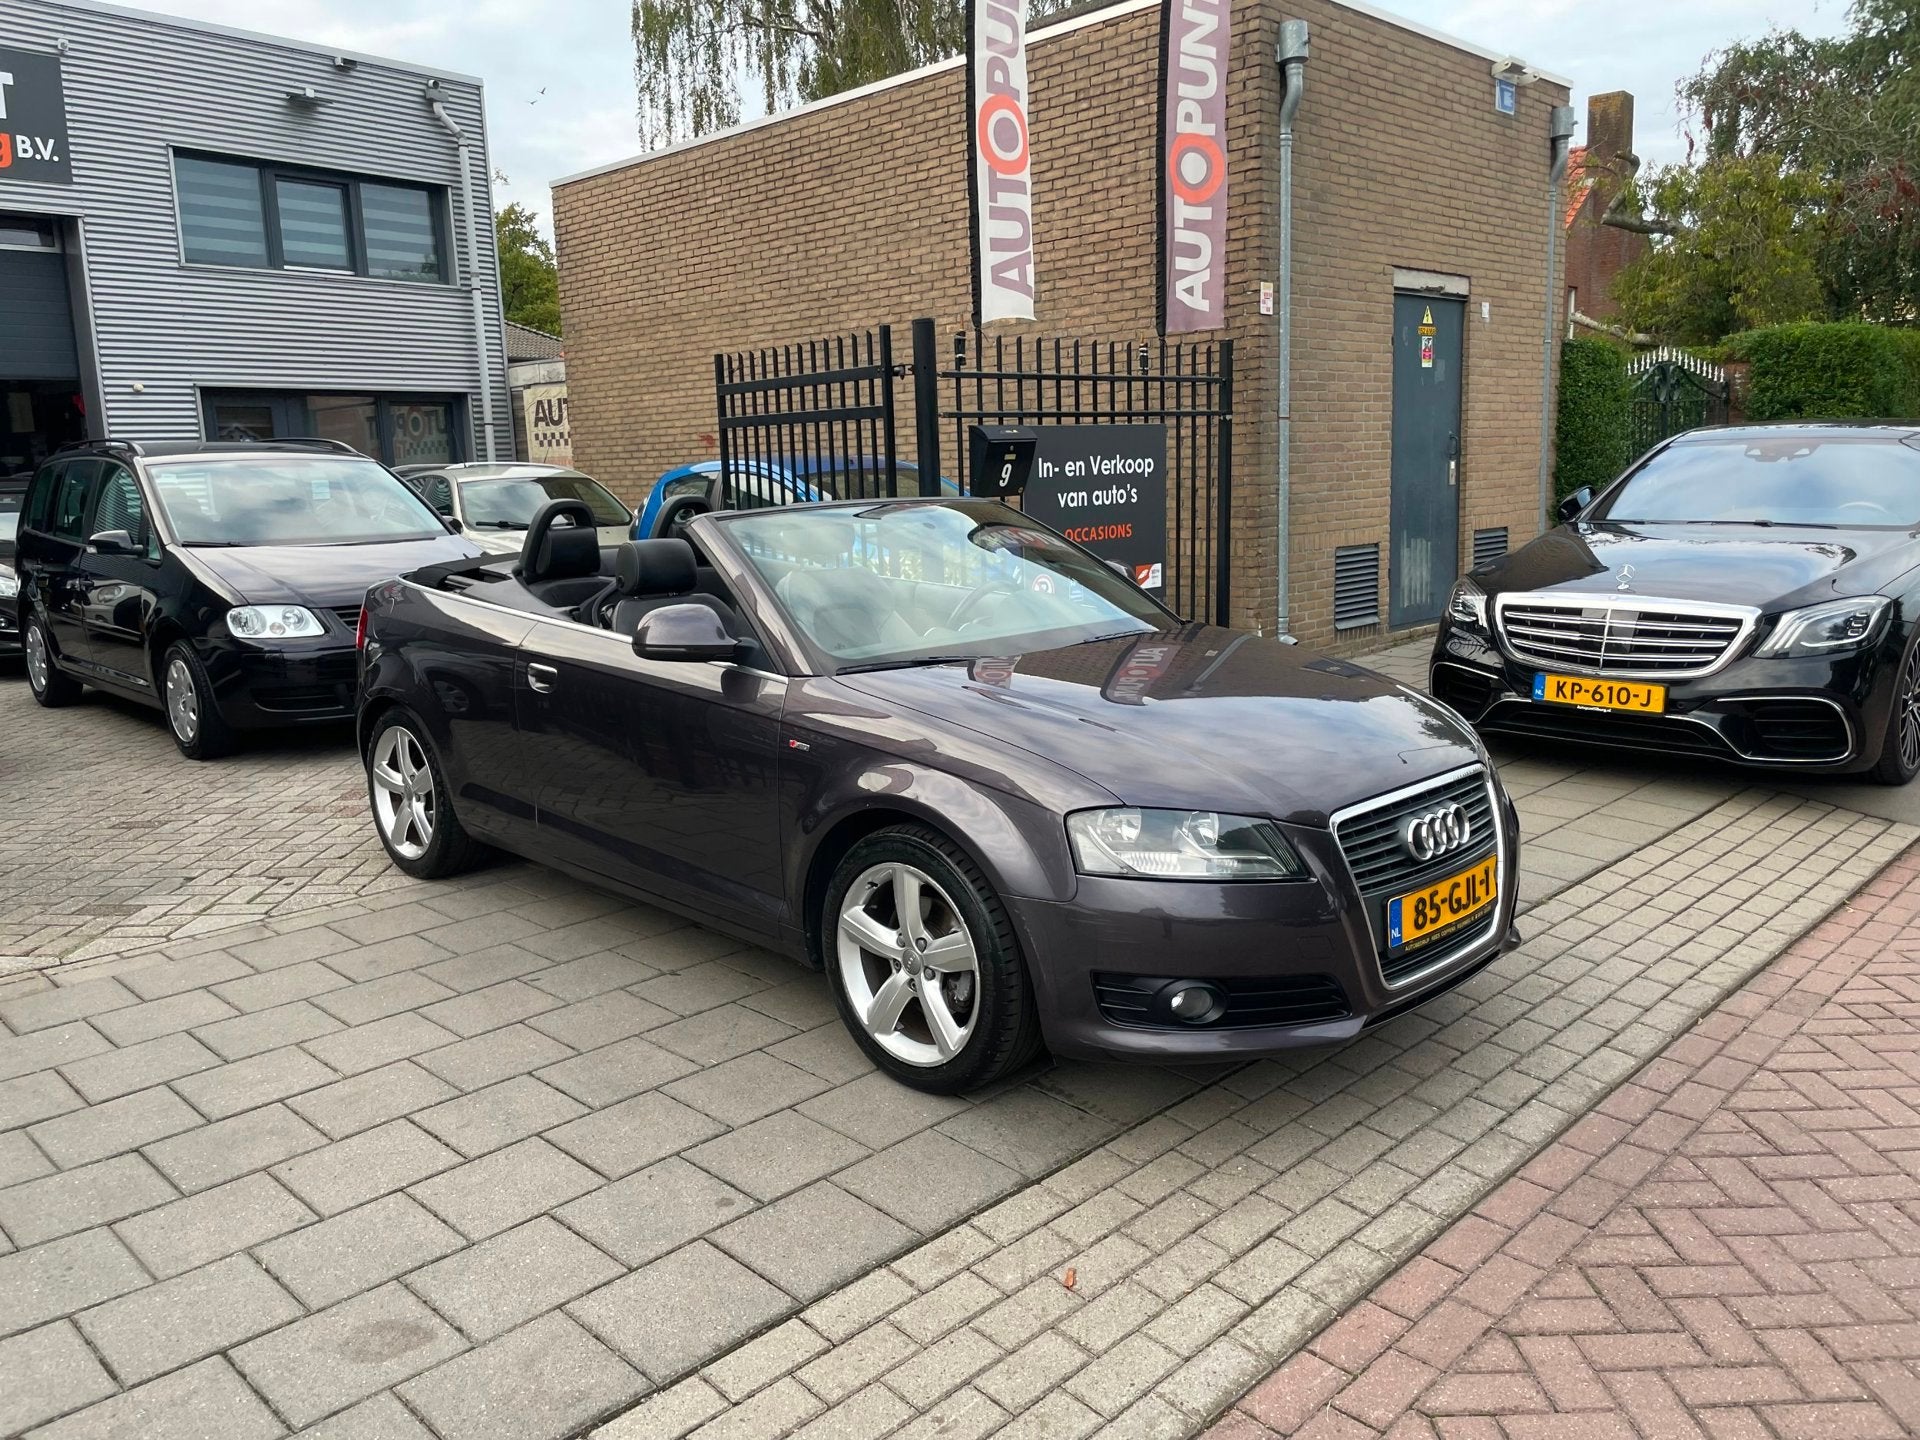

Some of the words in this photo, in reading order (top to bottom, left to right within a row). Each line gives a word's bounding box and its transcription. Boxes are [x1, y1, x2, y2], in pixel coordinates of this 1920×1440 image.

[15, 134, 59, 163] B.V.
[978, 0, 1034, 299] AUTOPU
[1169, 0, 1226, 312] AUTOPUN
[534, 397, 568, 428] AU
[999, 463, 1012, 487] 9
[1038, 457, 1060, 478] In-
[1065, 460, 1085, 477] en
[1089, 454, 1154, 477] Verkoop
[1057, 491, 1088, 508] van
[1092, 484, 1138, 506] auto's
[1064, 523, 1132, 542] OCCASIONS
[1535, 688, 1544, 696] NL
[1555, 680, 1652, 707] KP-610-J
[1391, 927, 1401, 939] NL
[1414, 866, 1490, 931] 85-GJL-1
